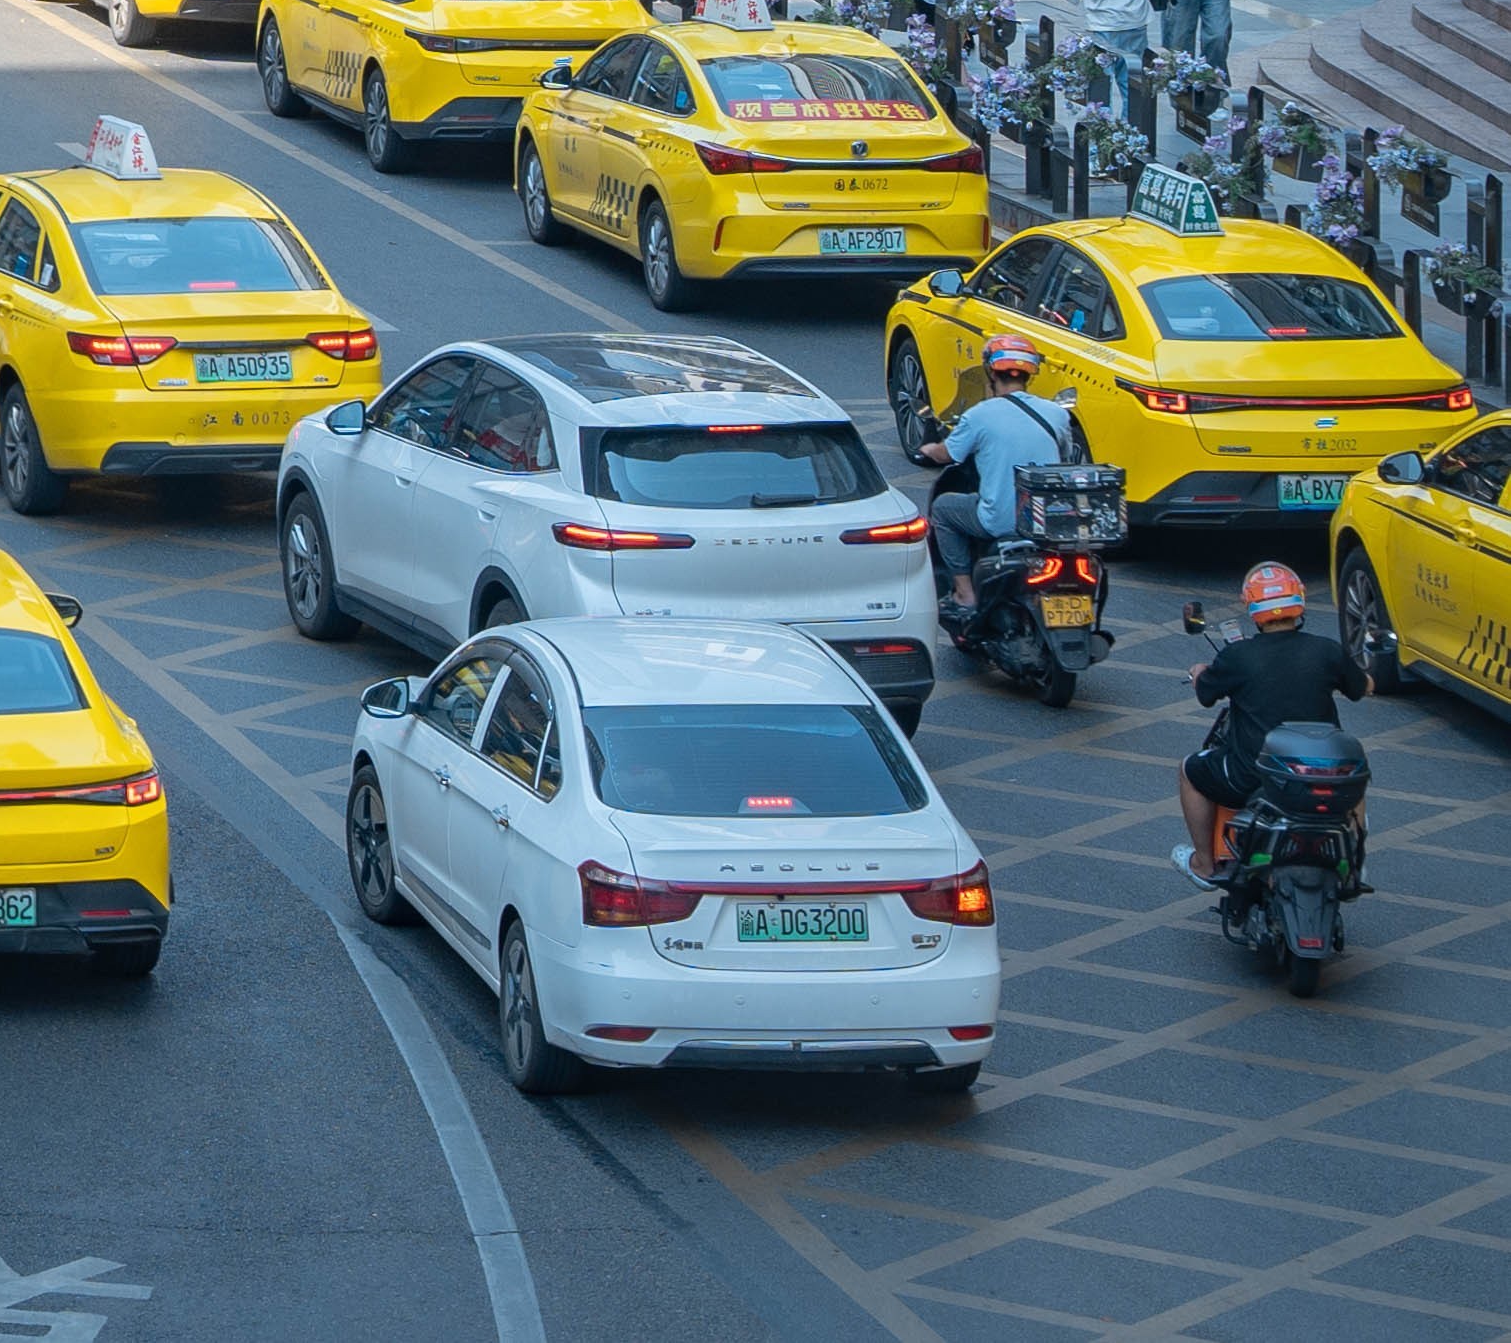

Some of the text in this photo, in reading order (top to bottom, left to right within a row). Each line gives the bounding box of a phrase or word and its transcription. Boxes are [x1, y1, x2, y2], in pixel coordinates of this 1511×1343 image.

[735, 100, 925, 121] 观音桥好吃街
[862, 178, 889, 190] 0672
[847, 229, 902, 249] AF2907
[227, 356, 290, 378] A50935
[251, 412, 291, 426] 0073
[1329, 438, 1357, 451] 2032
[781, 911, 866, 936] DG3200
